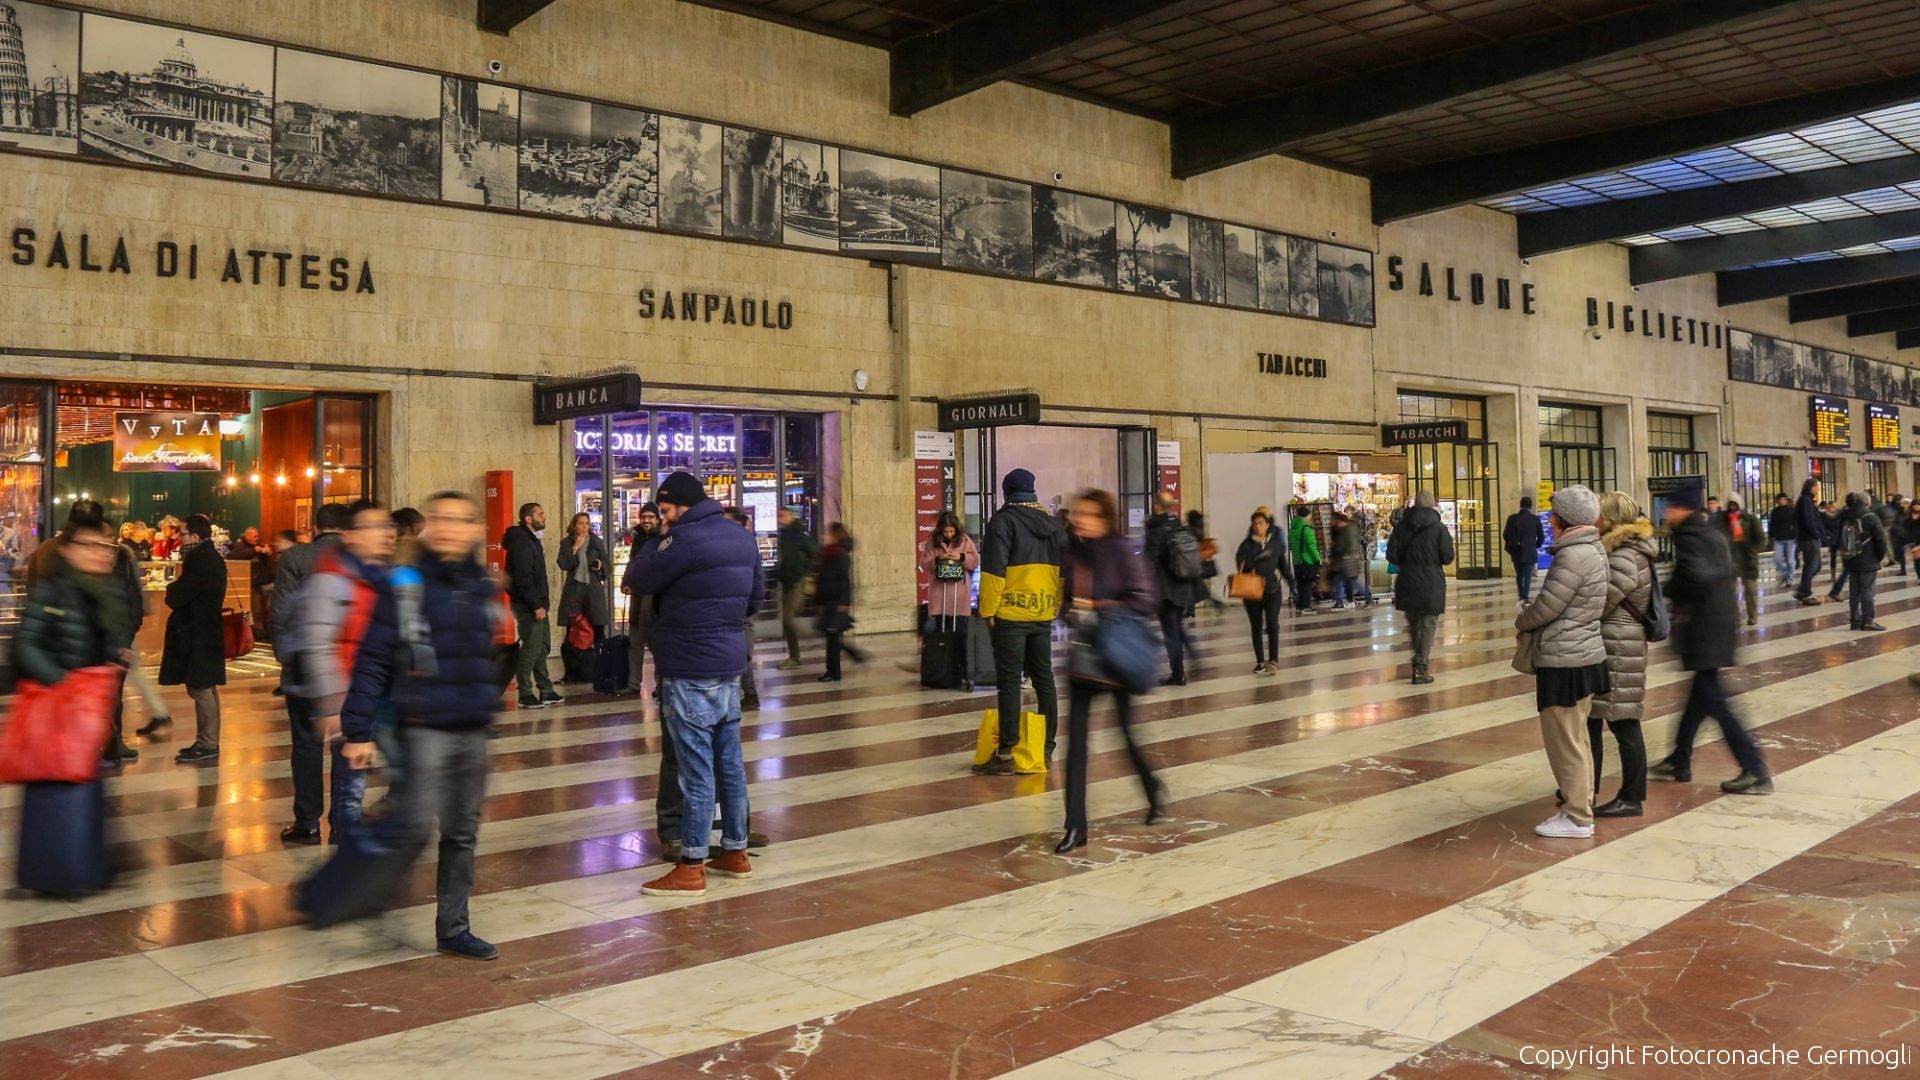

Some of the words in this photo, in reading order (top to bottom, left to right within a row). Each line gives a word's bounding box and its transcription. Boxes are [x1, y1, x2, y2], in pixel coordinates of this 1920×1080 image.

[12, 227, 131, 274] SALA
[157, 241, 197, 279] DI
[221, 248, 375, 294] ATTESA
[639, 288, 793, 330] SANPAOLO
[1388, 256, 1535, 315] SALONE
[1587, 297, 1722, 349] BIGLIETTI
[1257, 352, 1327, 378] TABACCHI
[556, 386, 608, 409] BANCA
[951, 403, 1023, 422] GIORNALI
[673, 432, 737, 452] SECRET
[1392, 426, 1456, 441] TABACCHI
